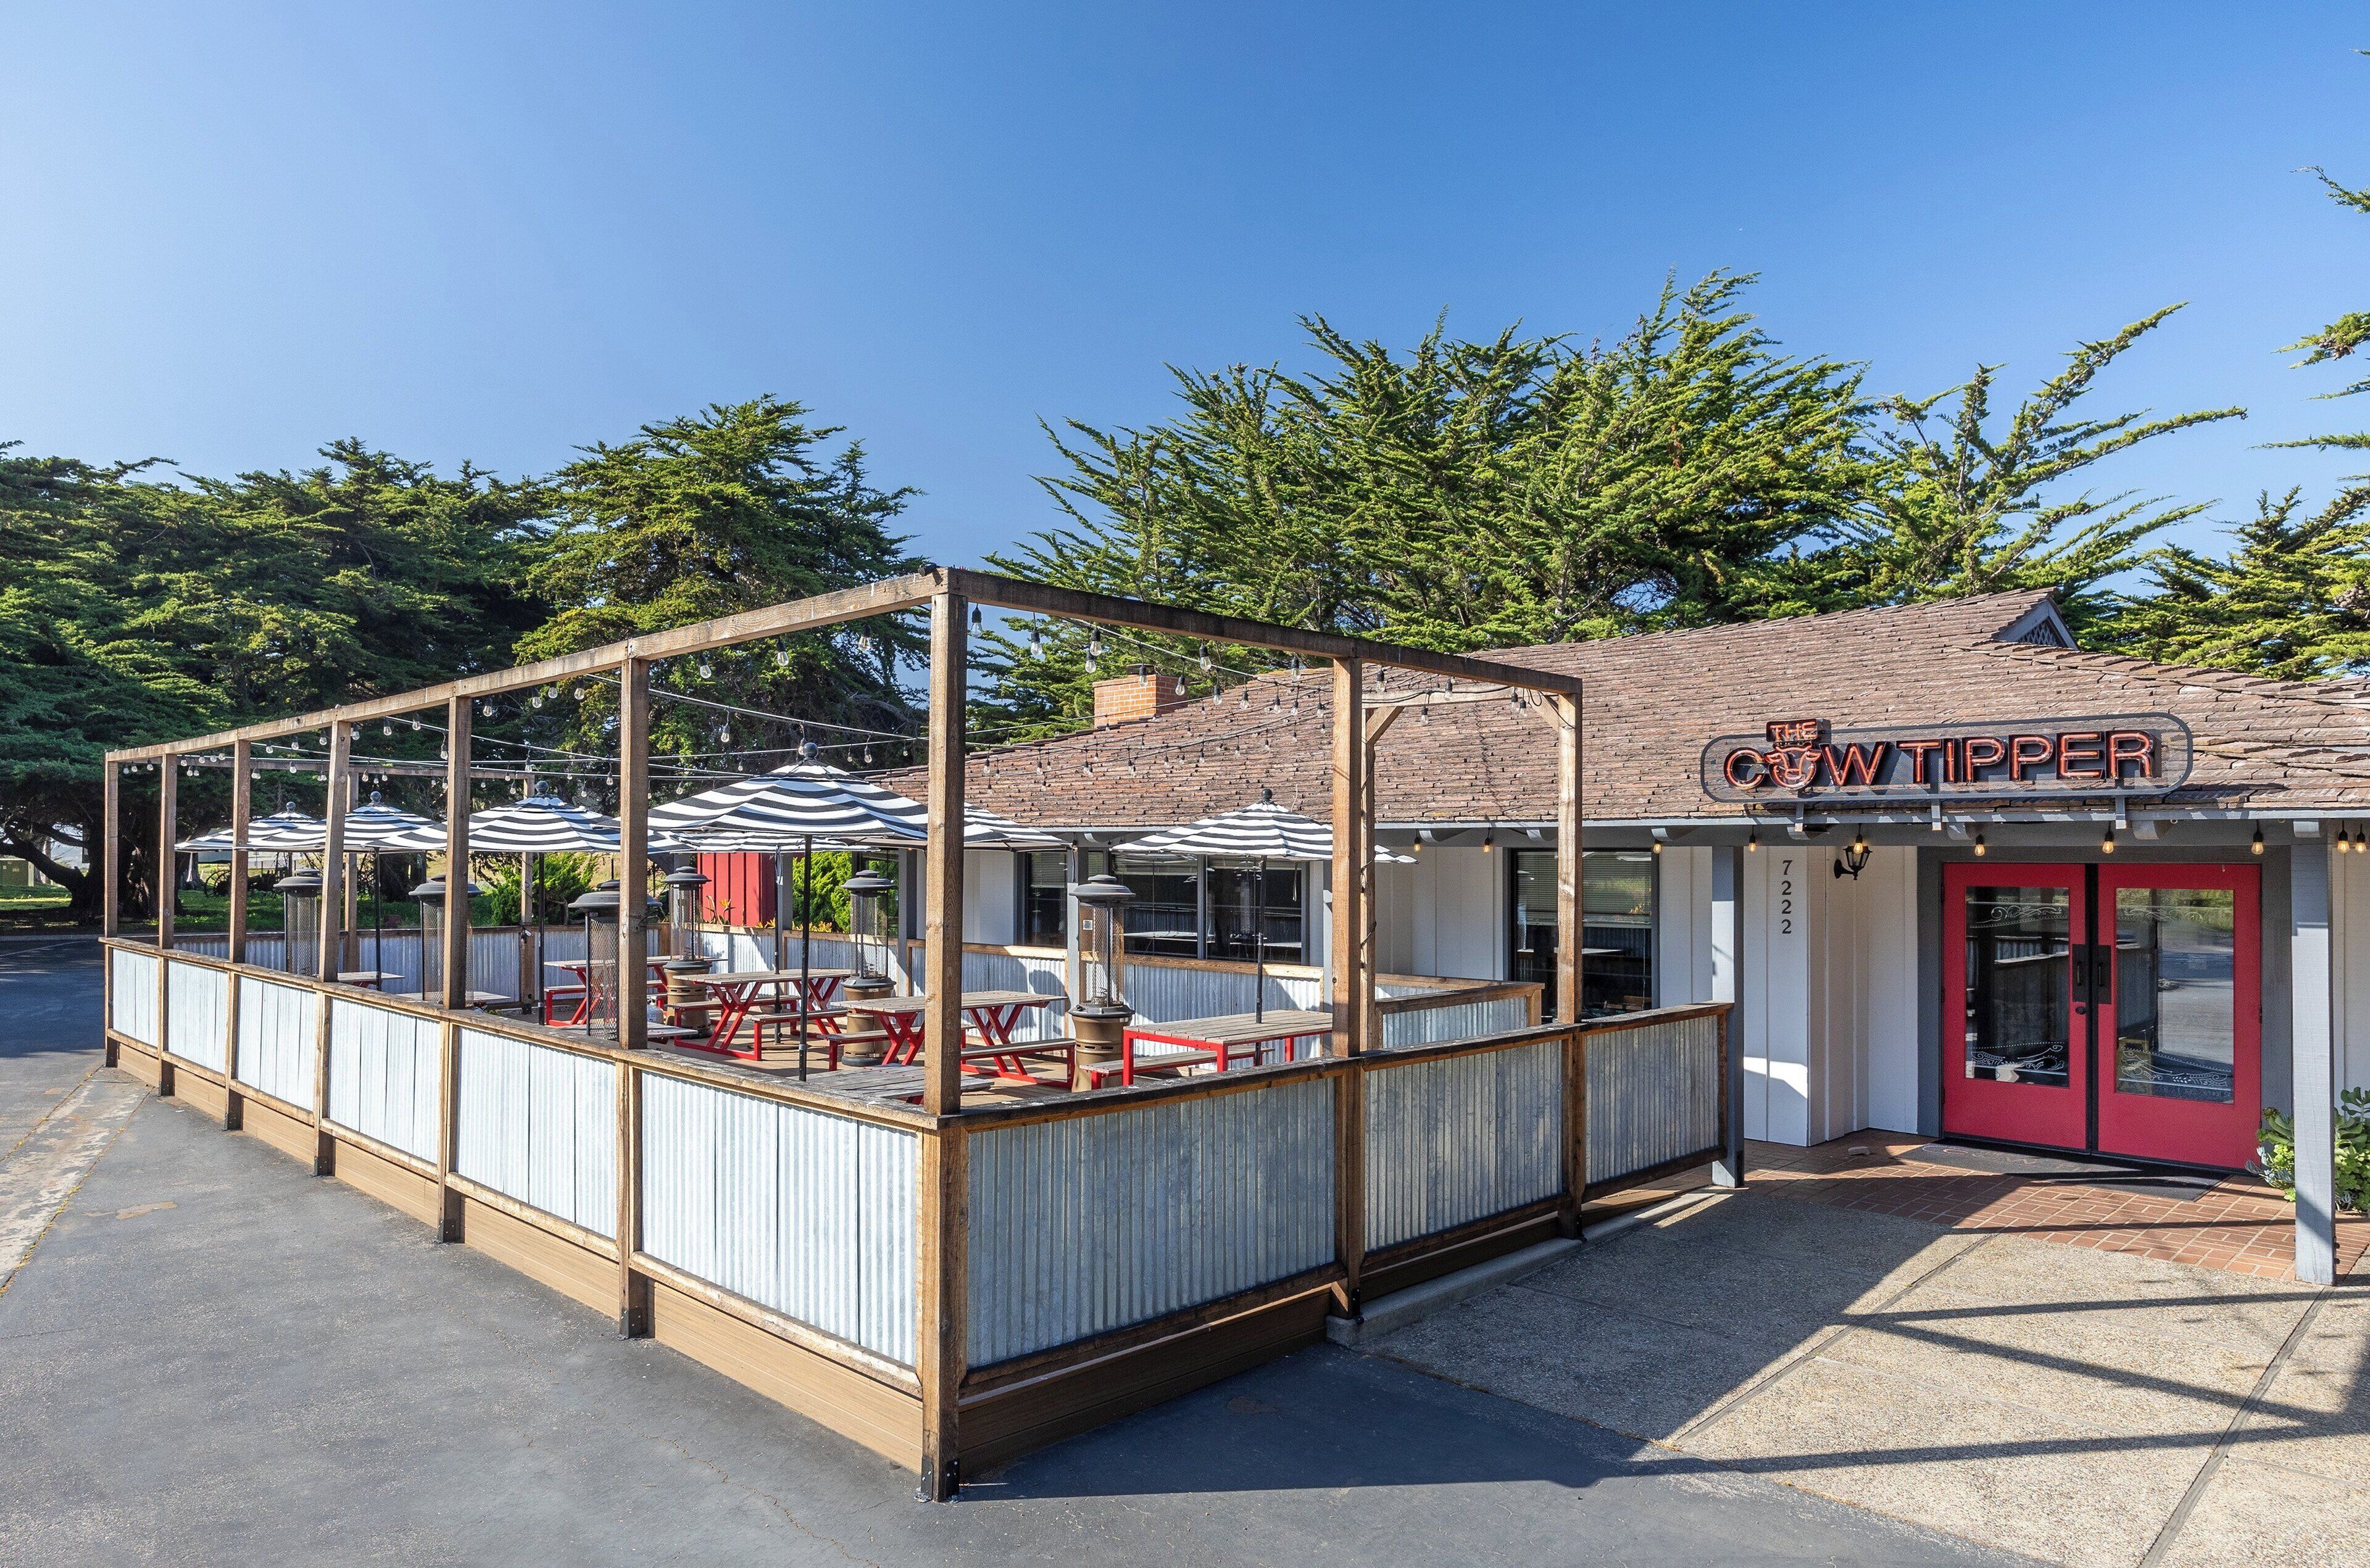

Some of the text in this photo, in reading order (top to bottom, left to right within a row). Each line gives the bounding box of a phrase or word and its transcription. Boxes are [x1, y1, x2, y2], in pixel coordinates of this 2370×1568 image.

[1723, 730, 2155, 790] COW TIPPER
[1769, 721, 1817, 740] THE
[1781, 860, 1793, 934] 7222
